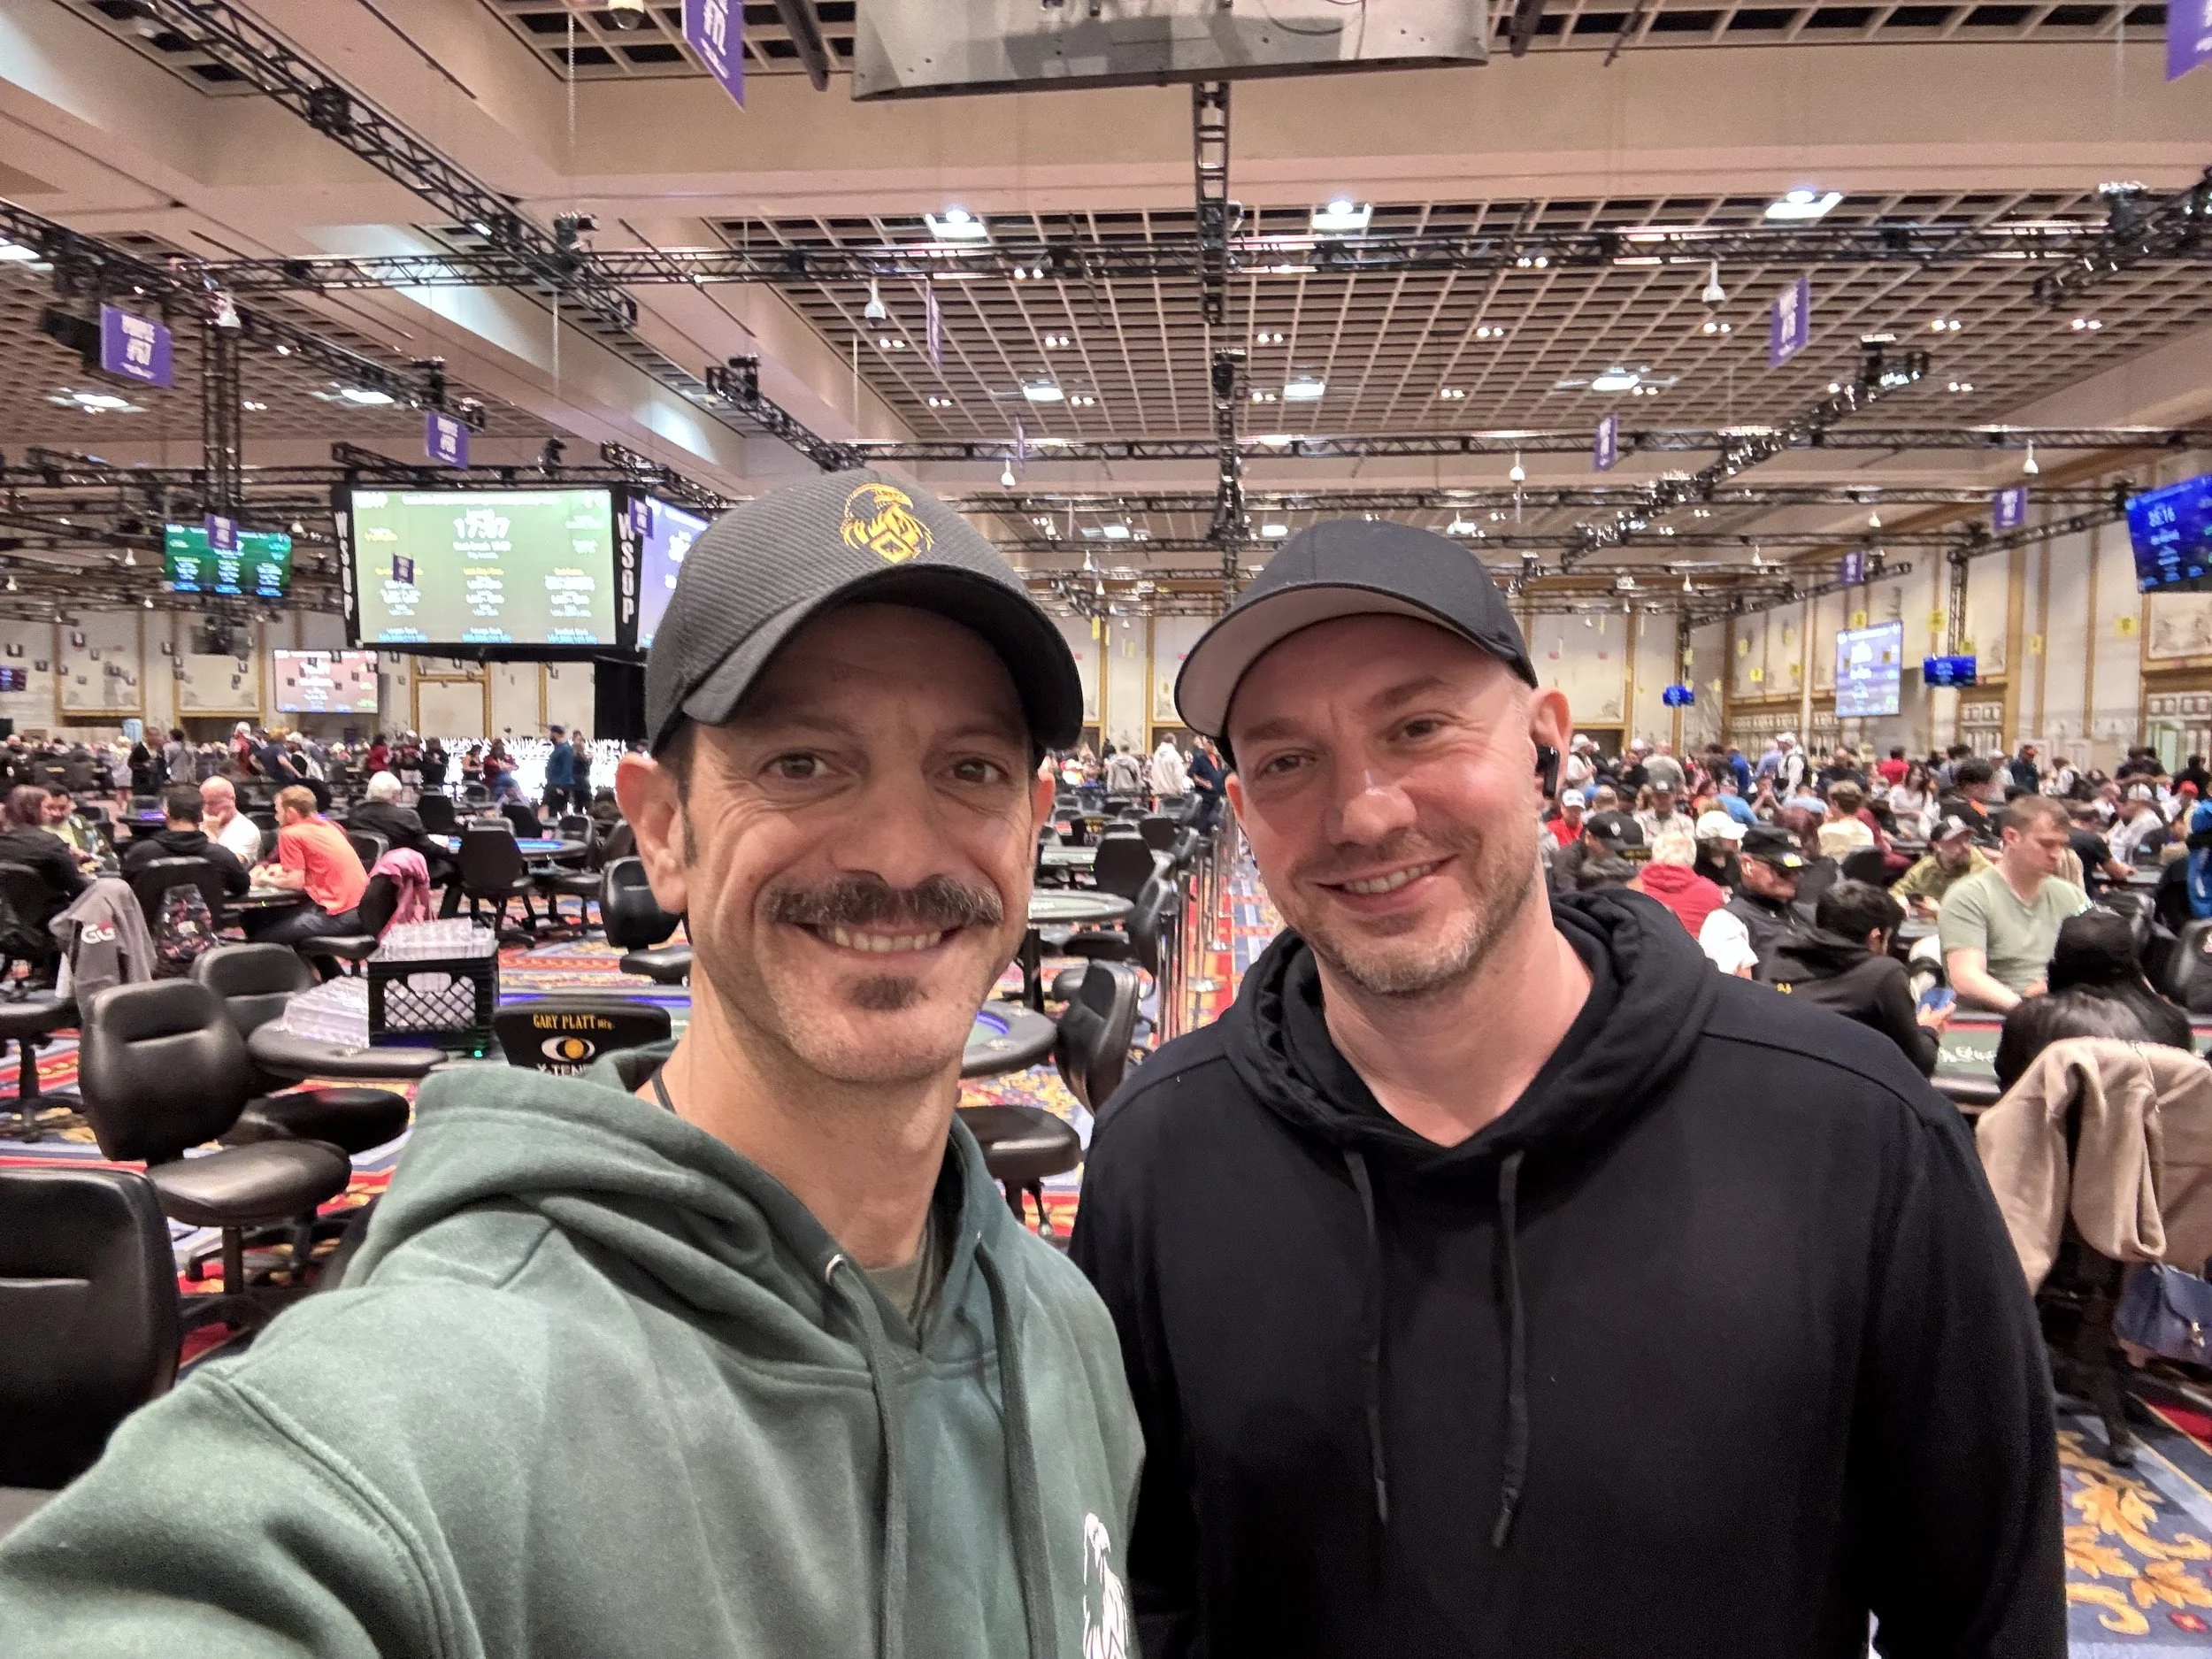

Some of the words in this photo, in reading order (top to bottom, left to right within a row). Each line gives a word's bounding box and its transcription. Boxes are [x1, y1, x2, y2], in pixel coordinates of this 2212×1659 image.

[334, 511, 354, 621] WSOP
[617, 512, 635, 625] WSOP
[533, 1012, 558, 1030] GARY
[562, 1014, 595, 1030] PLATT
